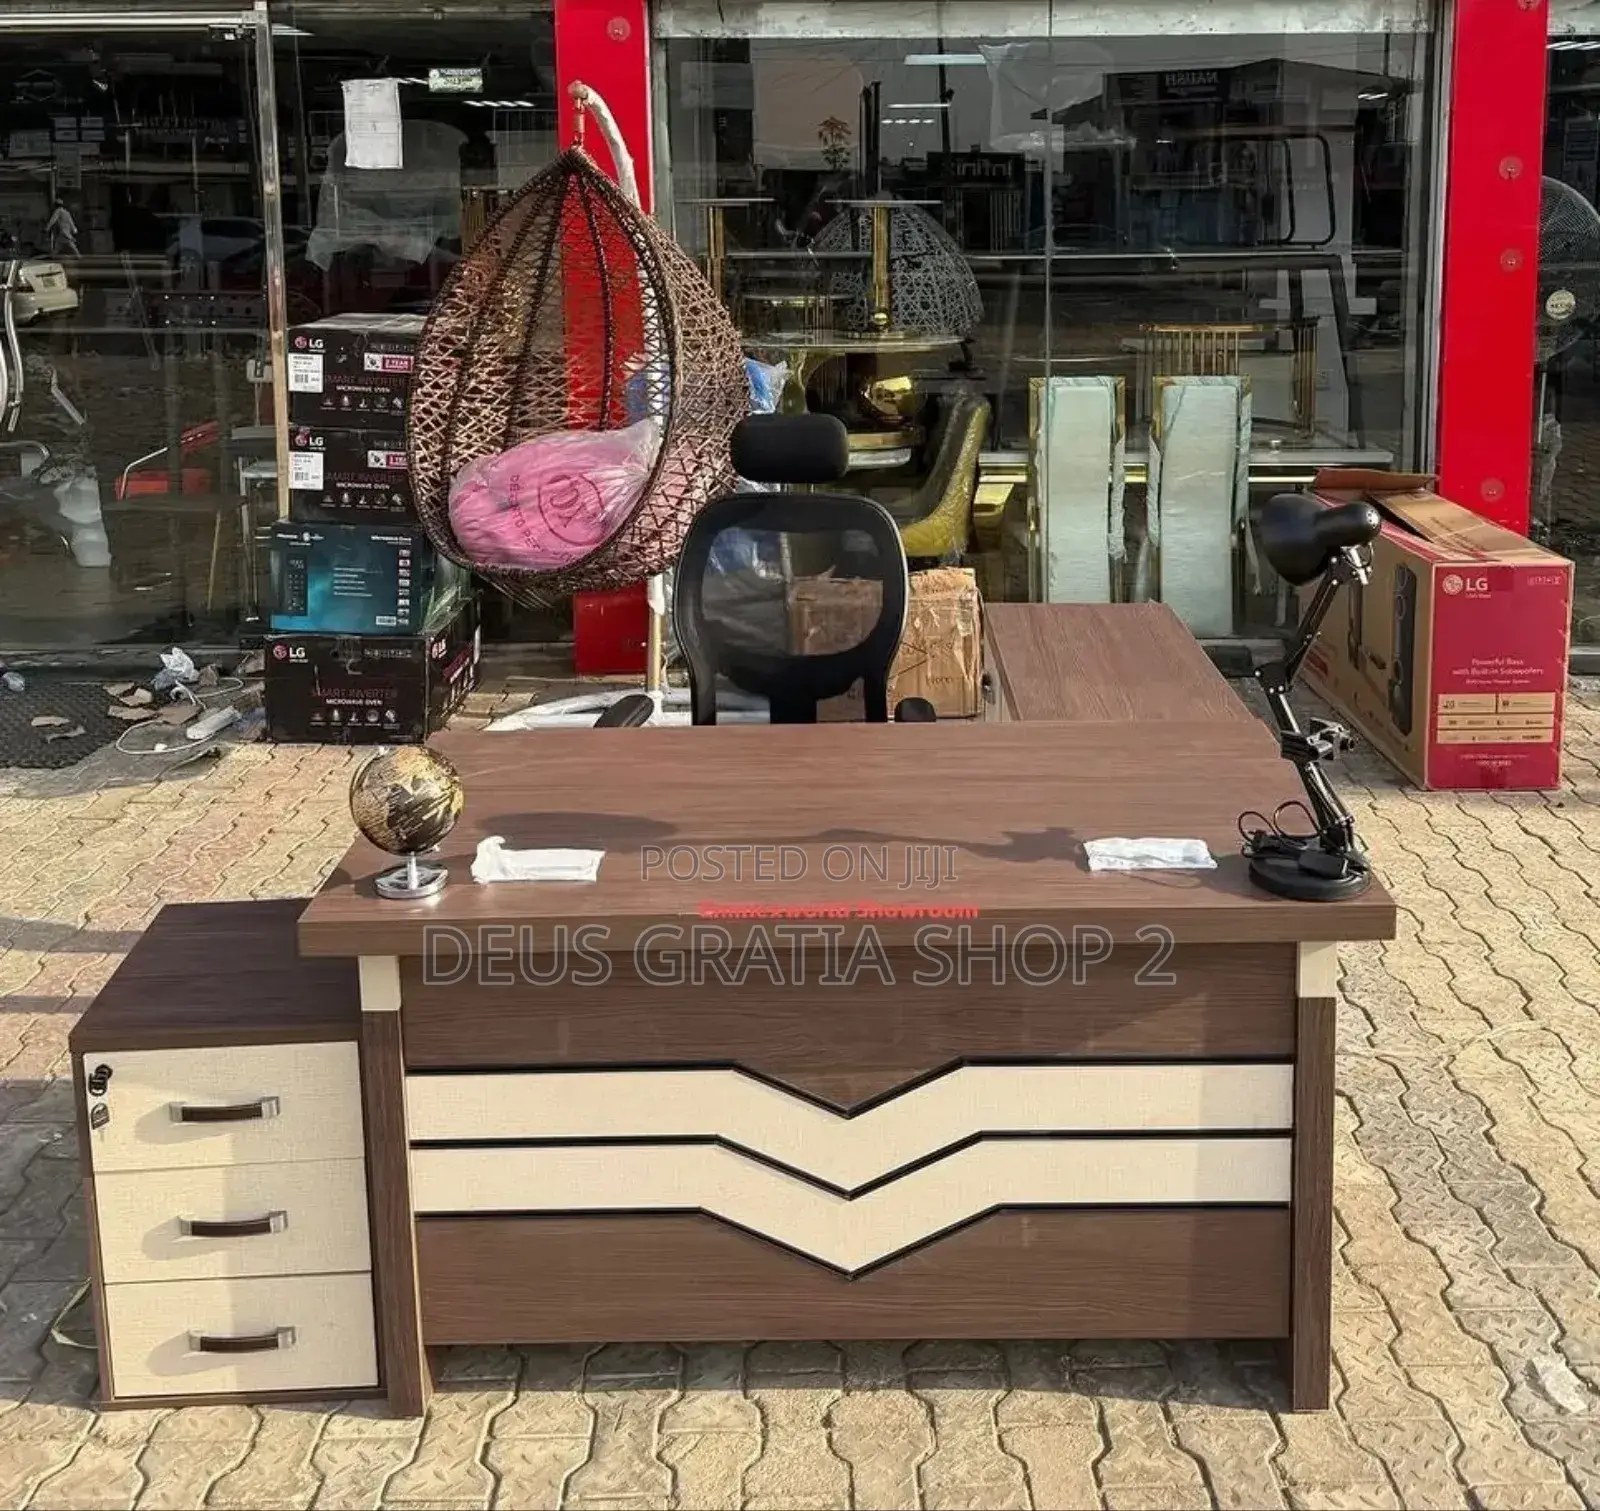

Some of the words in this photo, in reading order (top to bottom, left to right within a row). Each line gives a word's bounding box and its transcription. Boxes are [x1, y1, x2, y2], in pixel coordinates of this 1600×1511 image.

[308, 338, 324, 349] LG
[374, 386, 391, 394] OVEN
[309, 436, 324, 447] LG
[1466, 577, 1488, 592] LG
[289, 647, 306, 659] LG
[1472, 658, 1505, 667] Powerful
[326, 698, 363, 706] MICROWAVE
